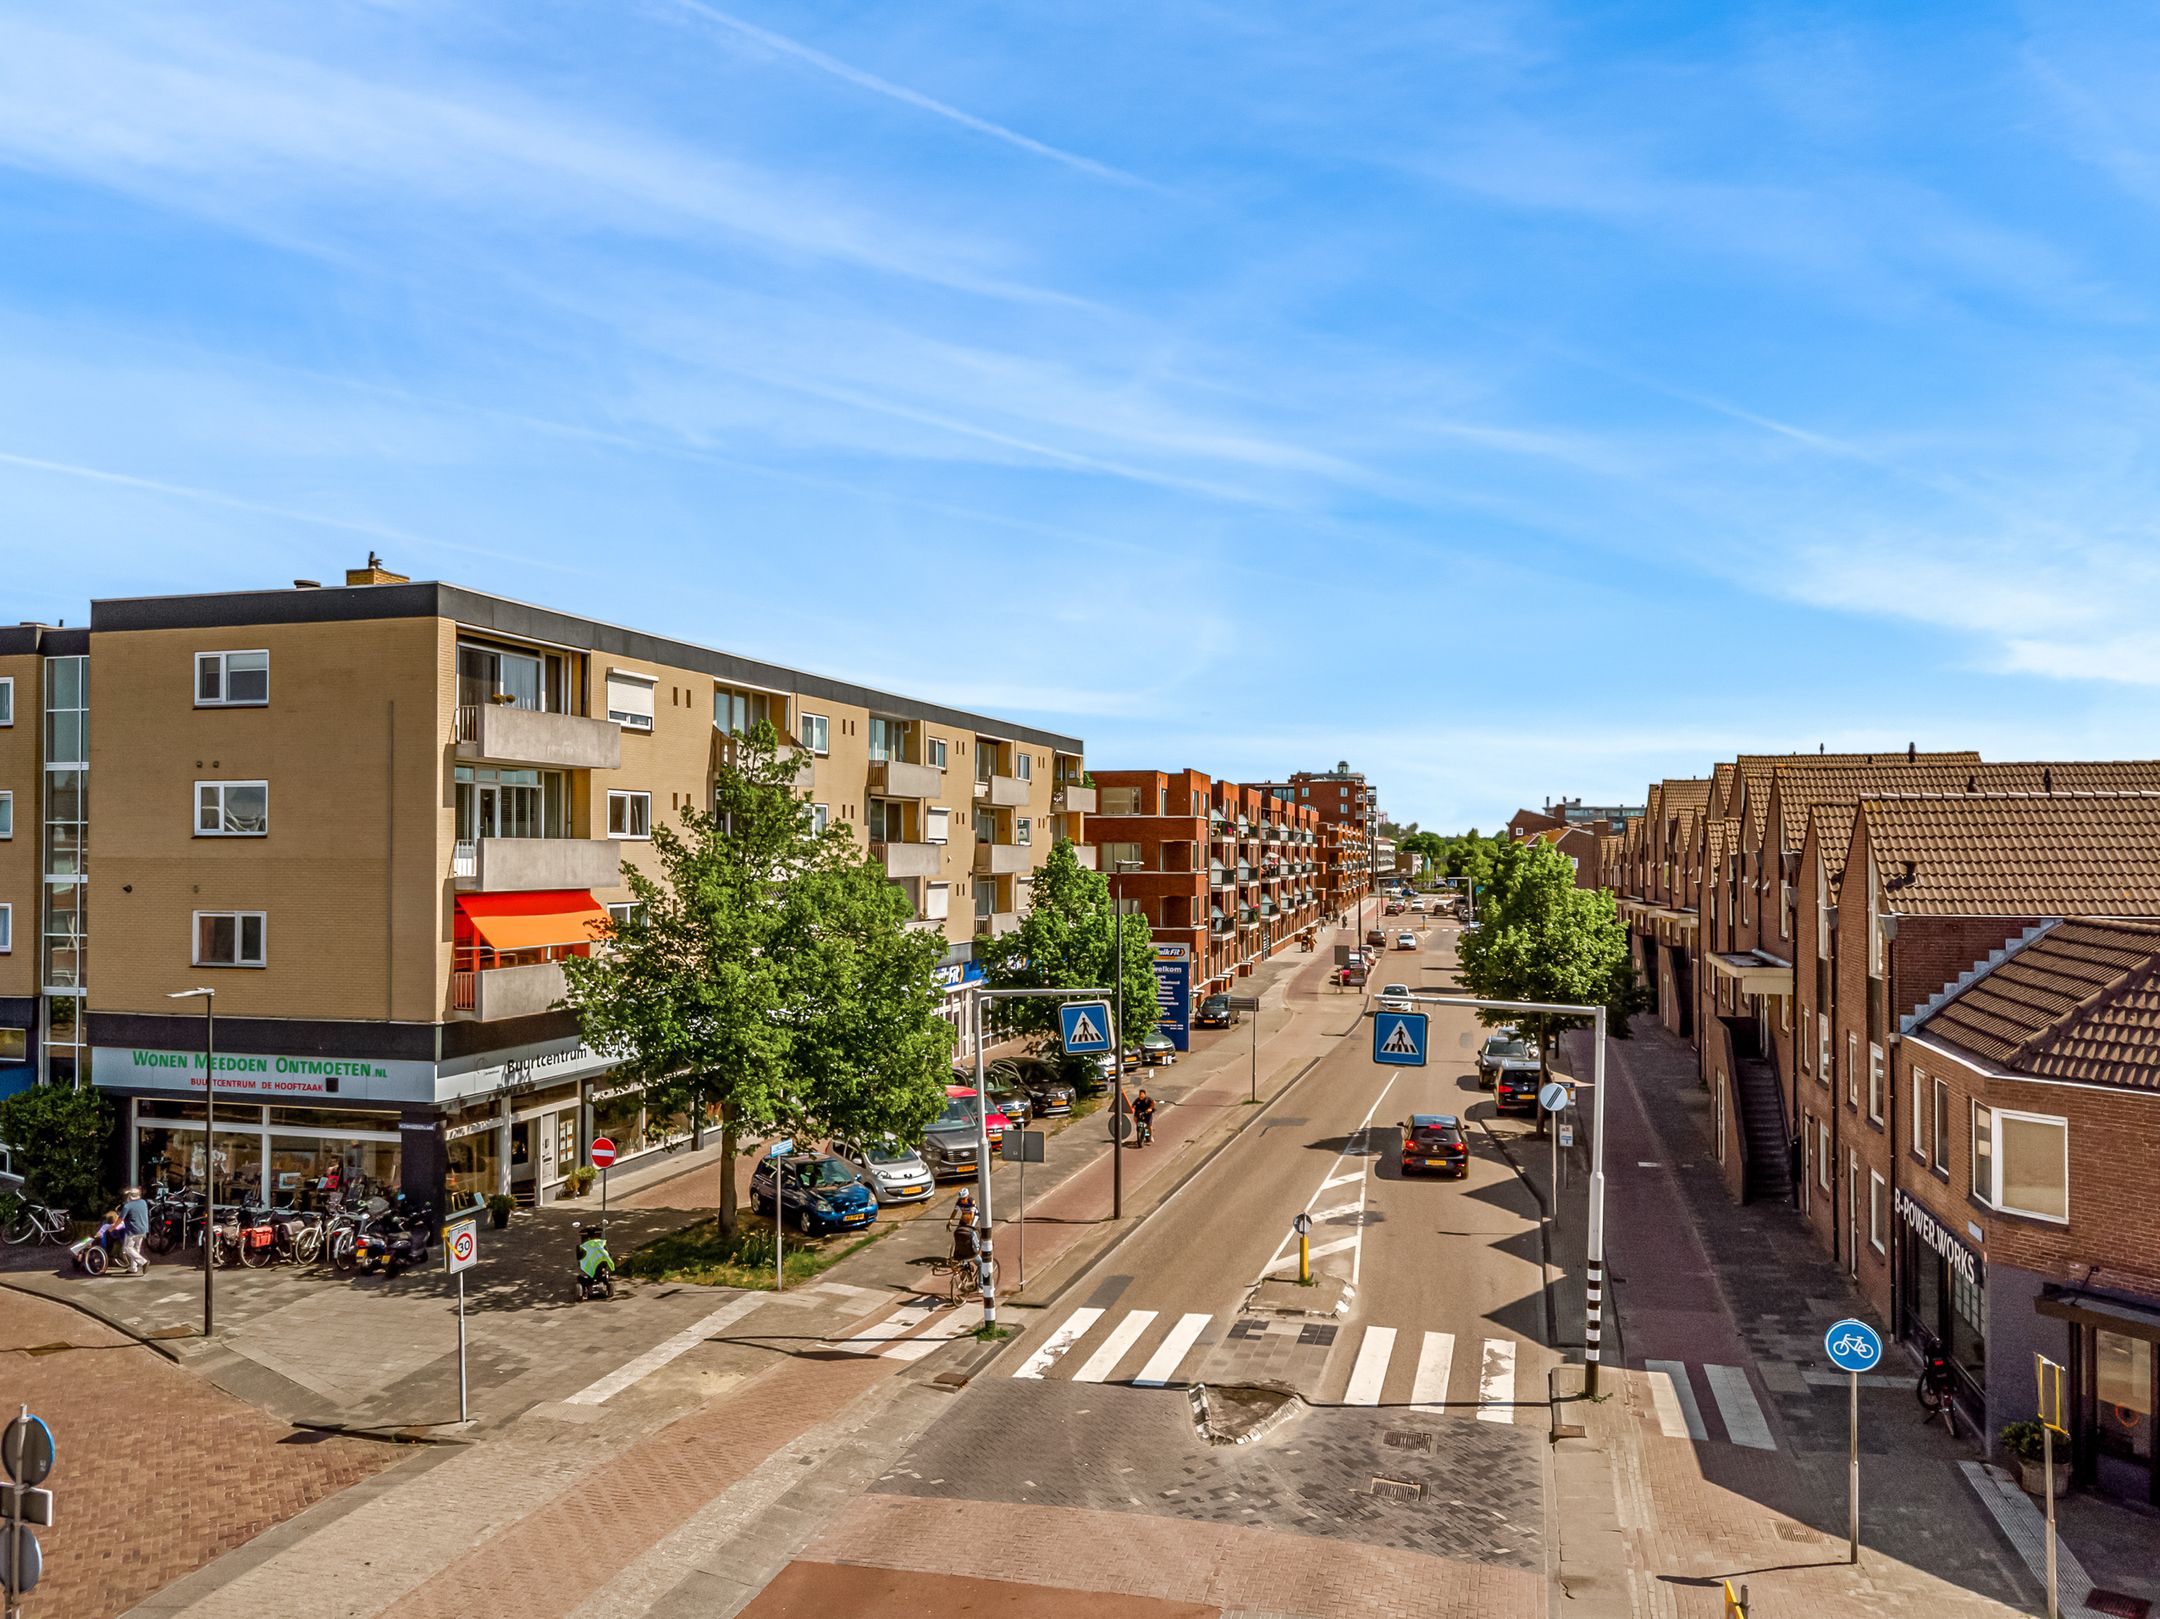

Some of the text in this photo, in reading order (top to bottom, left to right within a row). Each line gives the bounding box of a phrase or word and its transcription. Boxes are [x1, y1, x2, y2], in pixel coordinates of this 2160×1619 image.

[133, 1050, 188, 1069] WONEN
[194, 1053, 268, 1072] MEEDOEN
[506, 1048, 587, 1074] Buurtcentrum
[261, 1081, 272, 1090] DE
[274, 1082, 323, 1092] HOOFTZAAK
[458, 1240, 470, 1253] 30
[1894, 1187, 1975, 1284] B-POWER.WORKS
